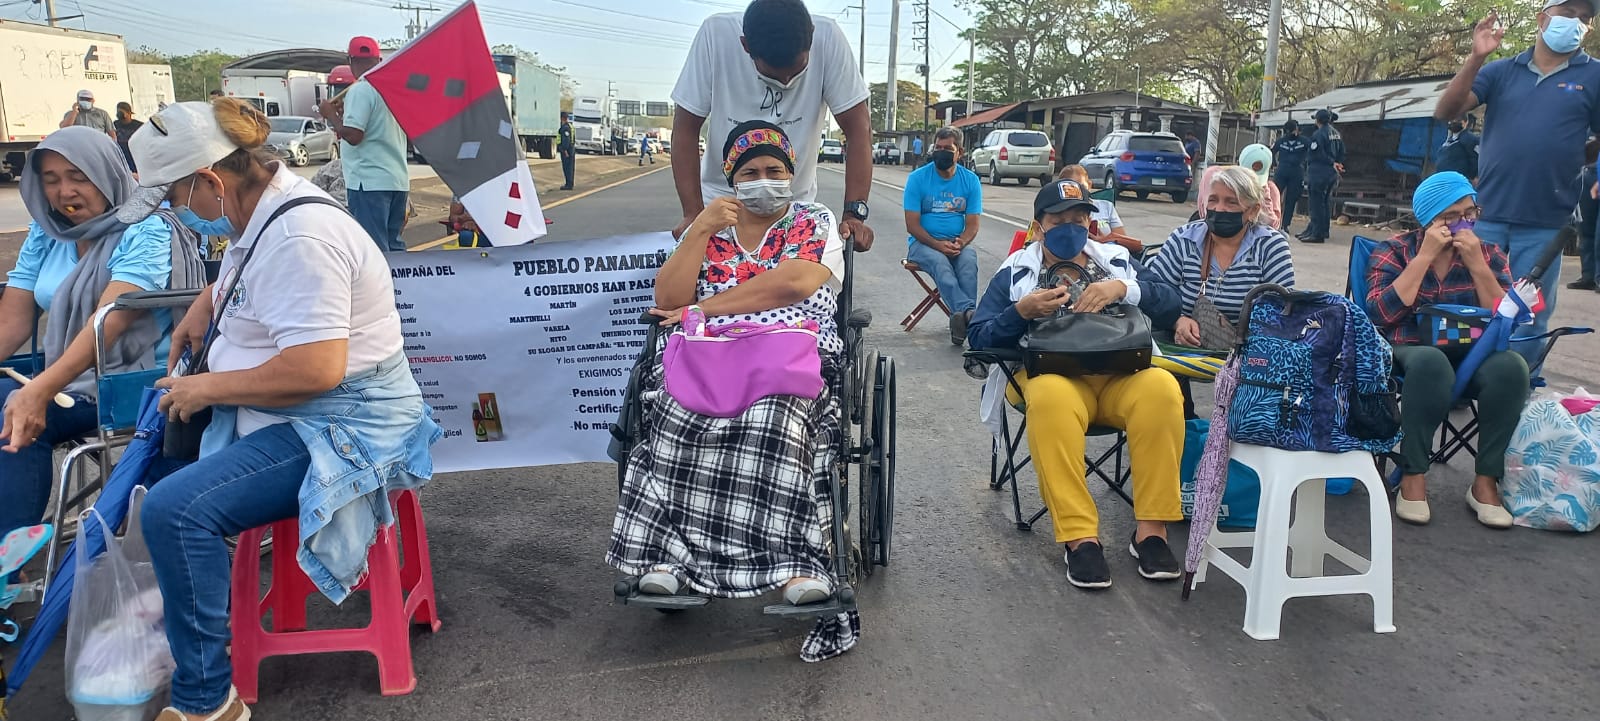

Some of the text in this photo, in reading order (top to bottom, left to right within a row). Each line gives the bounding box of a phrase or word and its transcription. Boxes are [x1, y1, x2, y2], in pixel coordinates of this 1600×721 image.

[513, 249, 667, 276] PUEBLO PANAMEÑ
[391, 265, 455, 279] AMPAÑA DEL
[524, 278, 656, 296] 4 GOBIERNOS HAN PASA
[630, 295, 653, 303] PUEDE
[550, 300, 577, 309] MARTÍN
[624, 306, 650, 314] ZAPATO
[510, 315, 551, 323] MARTINELLI
[550, 335, 567, 343] NITO
[601, 330, 632, 338] UNIENDO
[538, 346, 565, 354] SLOGAN
[577, 341, 612, 351] CAMPAÑA:
[564, 355, 575, 364] los
[577, 353, 626, 363] envenenados
[579, 367, 622, 378] EXIGIMOS
[575, 403, 623, 413] -Certific
